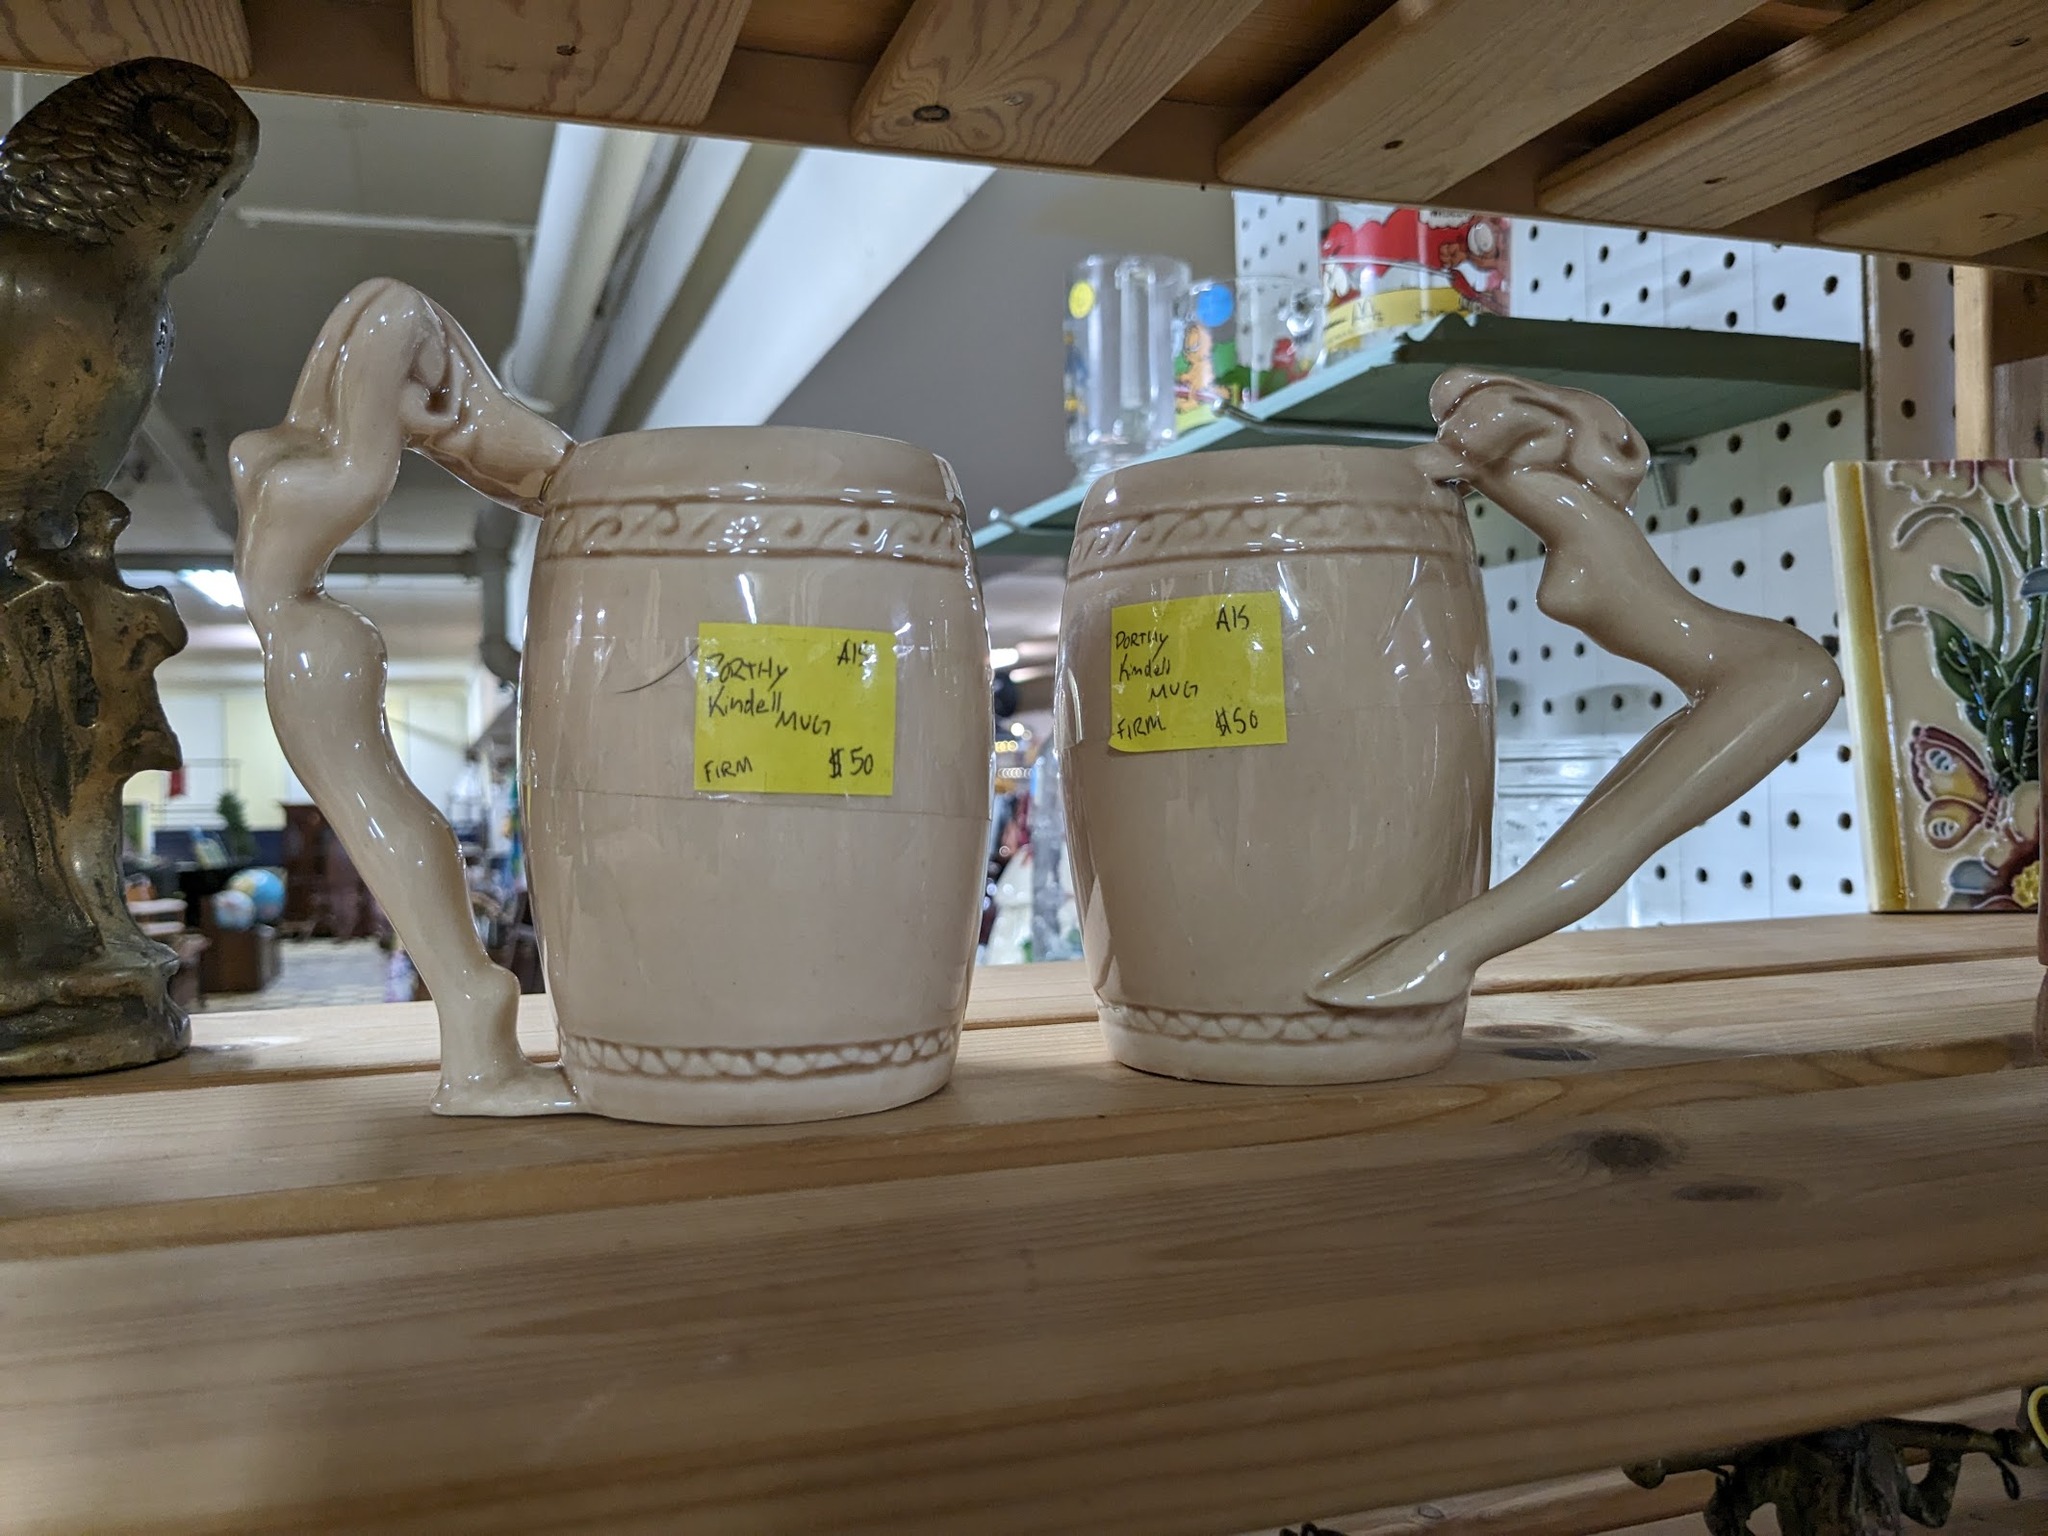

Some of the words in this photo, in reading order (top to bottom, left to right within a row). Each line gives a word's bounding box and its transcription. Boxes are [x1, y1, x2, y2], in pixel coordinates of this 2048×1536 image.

[709, 686, 782, 717] Kindell
[1148, 681, 1198, 702] MUG
[775, 711, 831, 735] MUG
[1117, 716, 1166, 740] FIRM
[1215, 707, 1258, 736] $50
[704, 756, 753, 783] FIRM
[829, 747, 874, 779] $50
